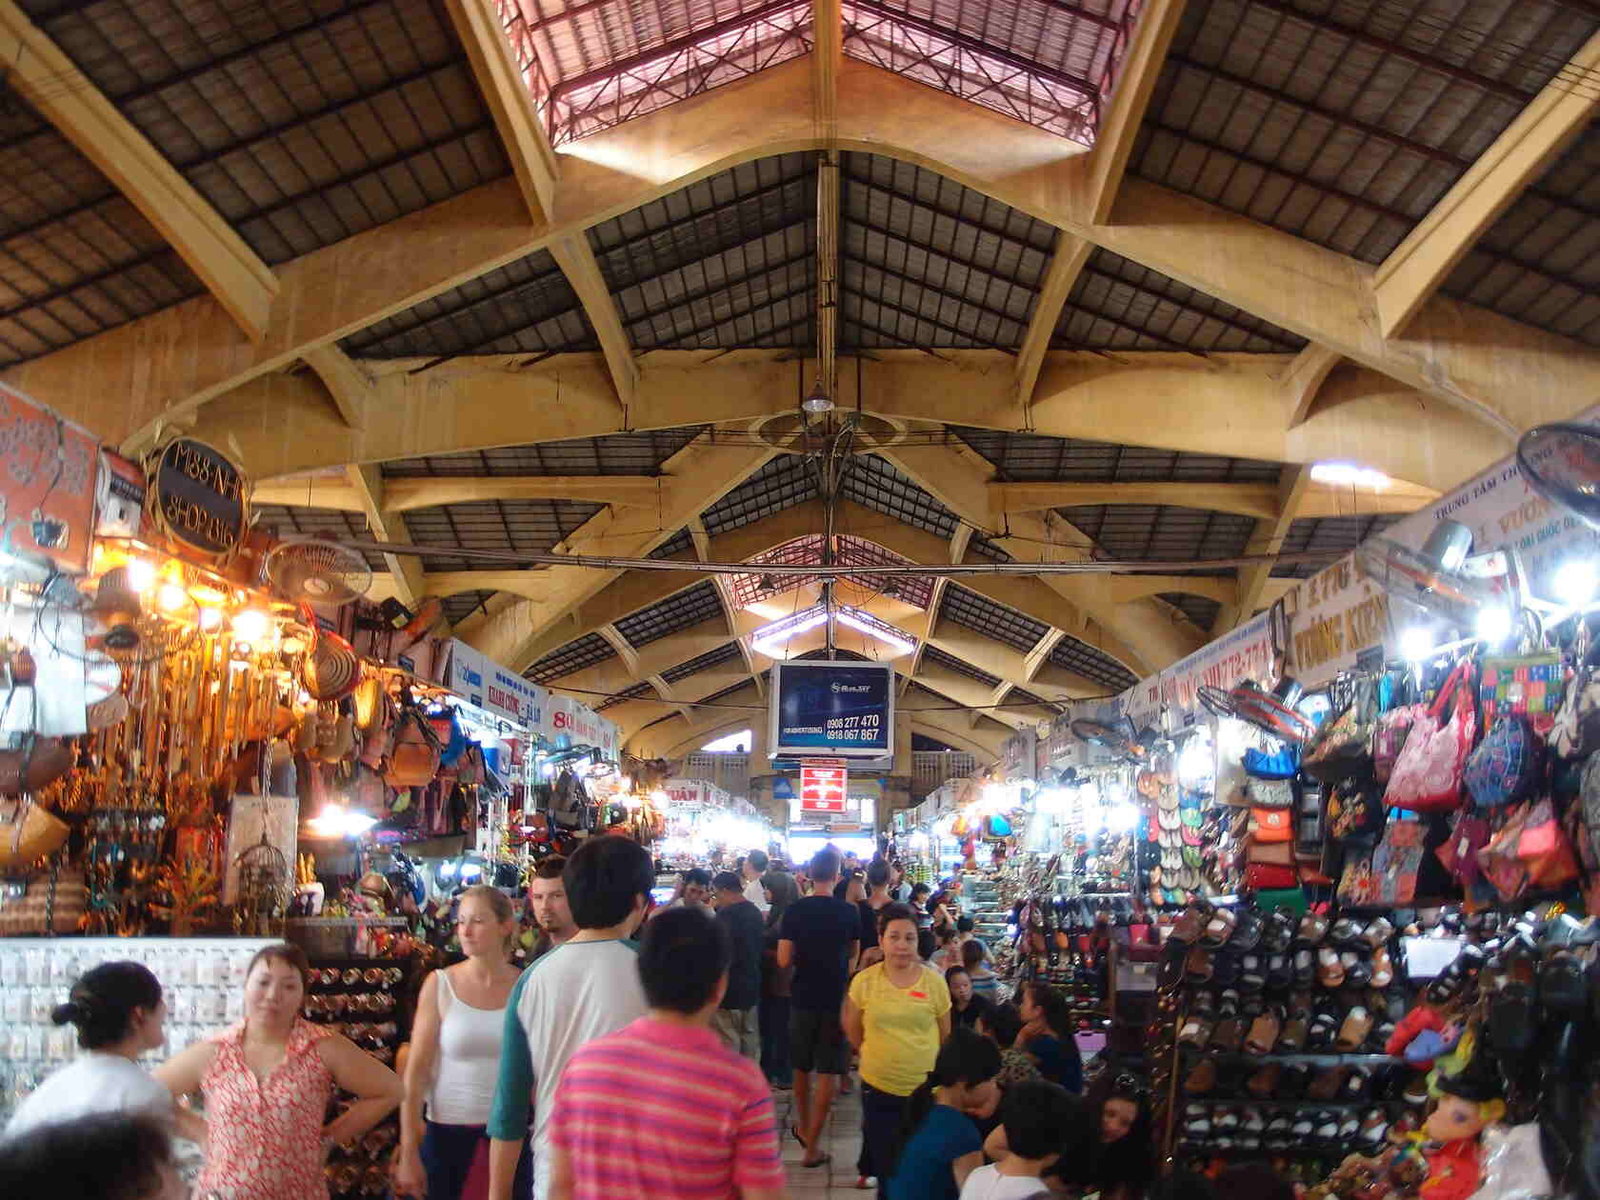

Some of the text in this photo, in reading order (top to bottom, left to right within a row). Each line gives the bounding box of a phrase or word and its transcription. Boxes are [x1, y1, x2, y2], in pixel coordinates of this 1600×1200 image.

[166, 493, 208, 534] SHOP
[826, 714, 880, 729] 0908 277 470
[826, 728, 880, 741] 0918 067 867
